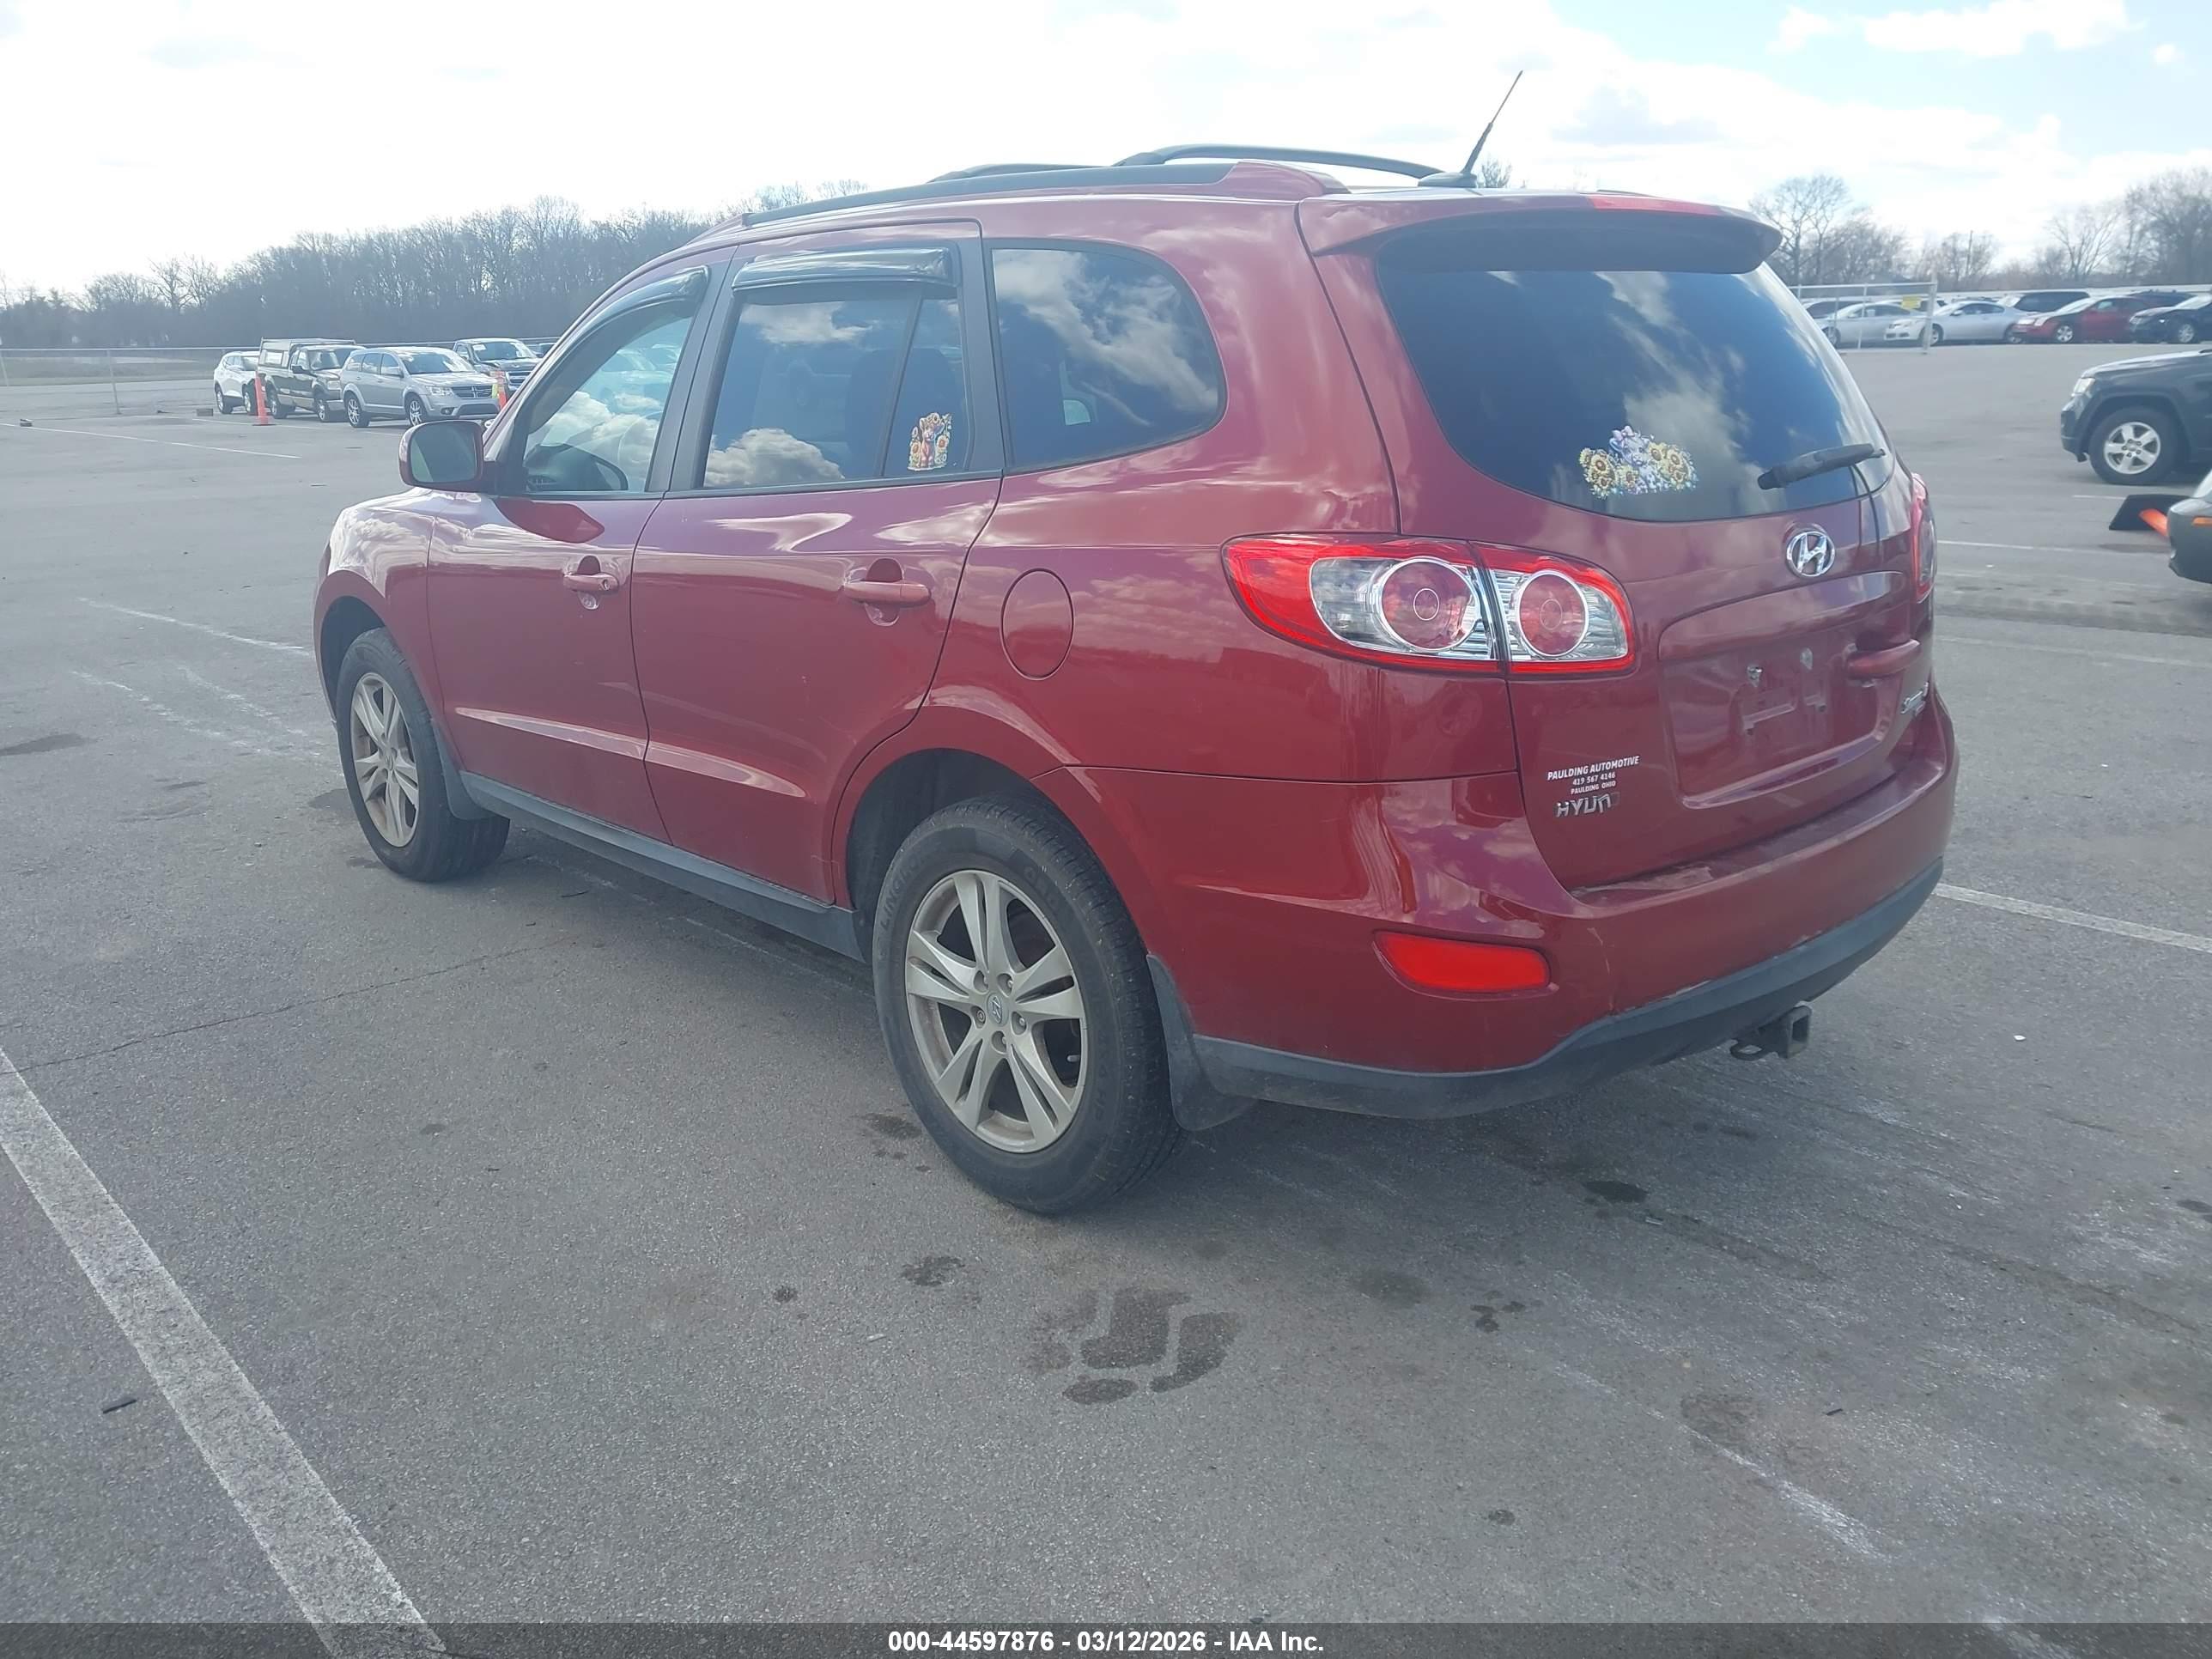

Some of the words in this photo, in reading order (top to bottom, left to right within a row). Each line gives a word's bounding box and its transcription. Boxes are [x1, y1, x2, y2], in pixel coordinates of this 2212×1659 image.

[1547, 765, 1589, 781] PAULDING
[1589, 756, 1640, 773] AUTOMOTIVE
[1571, 783, 1600, 795] PAULDING
[1601, 781, 1616, 789] OHIO
